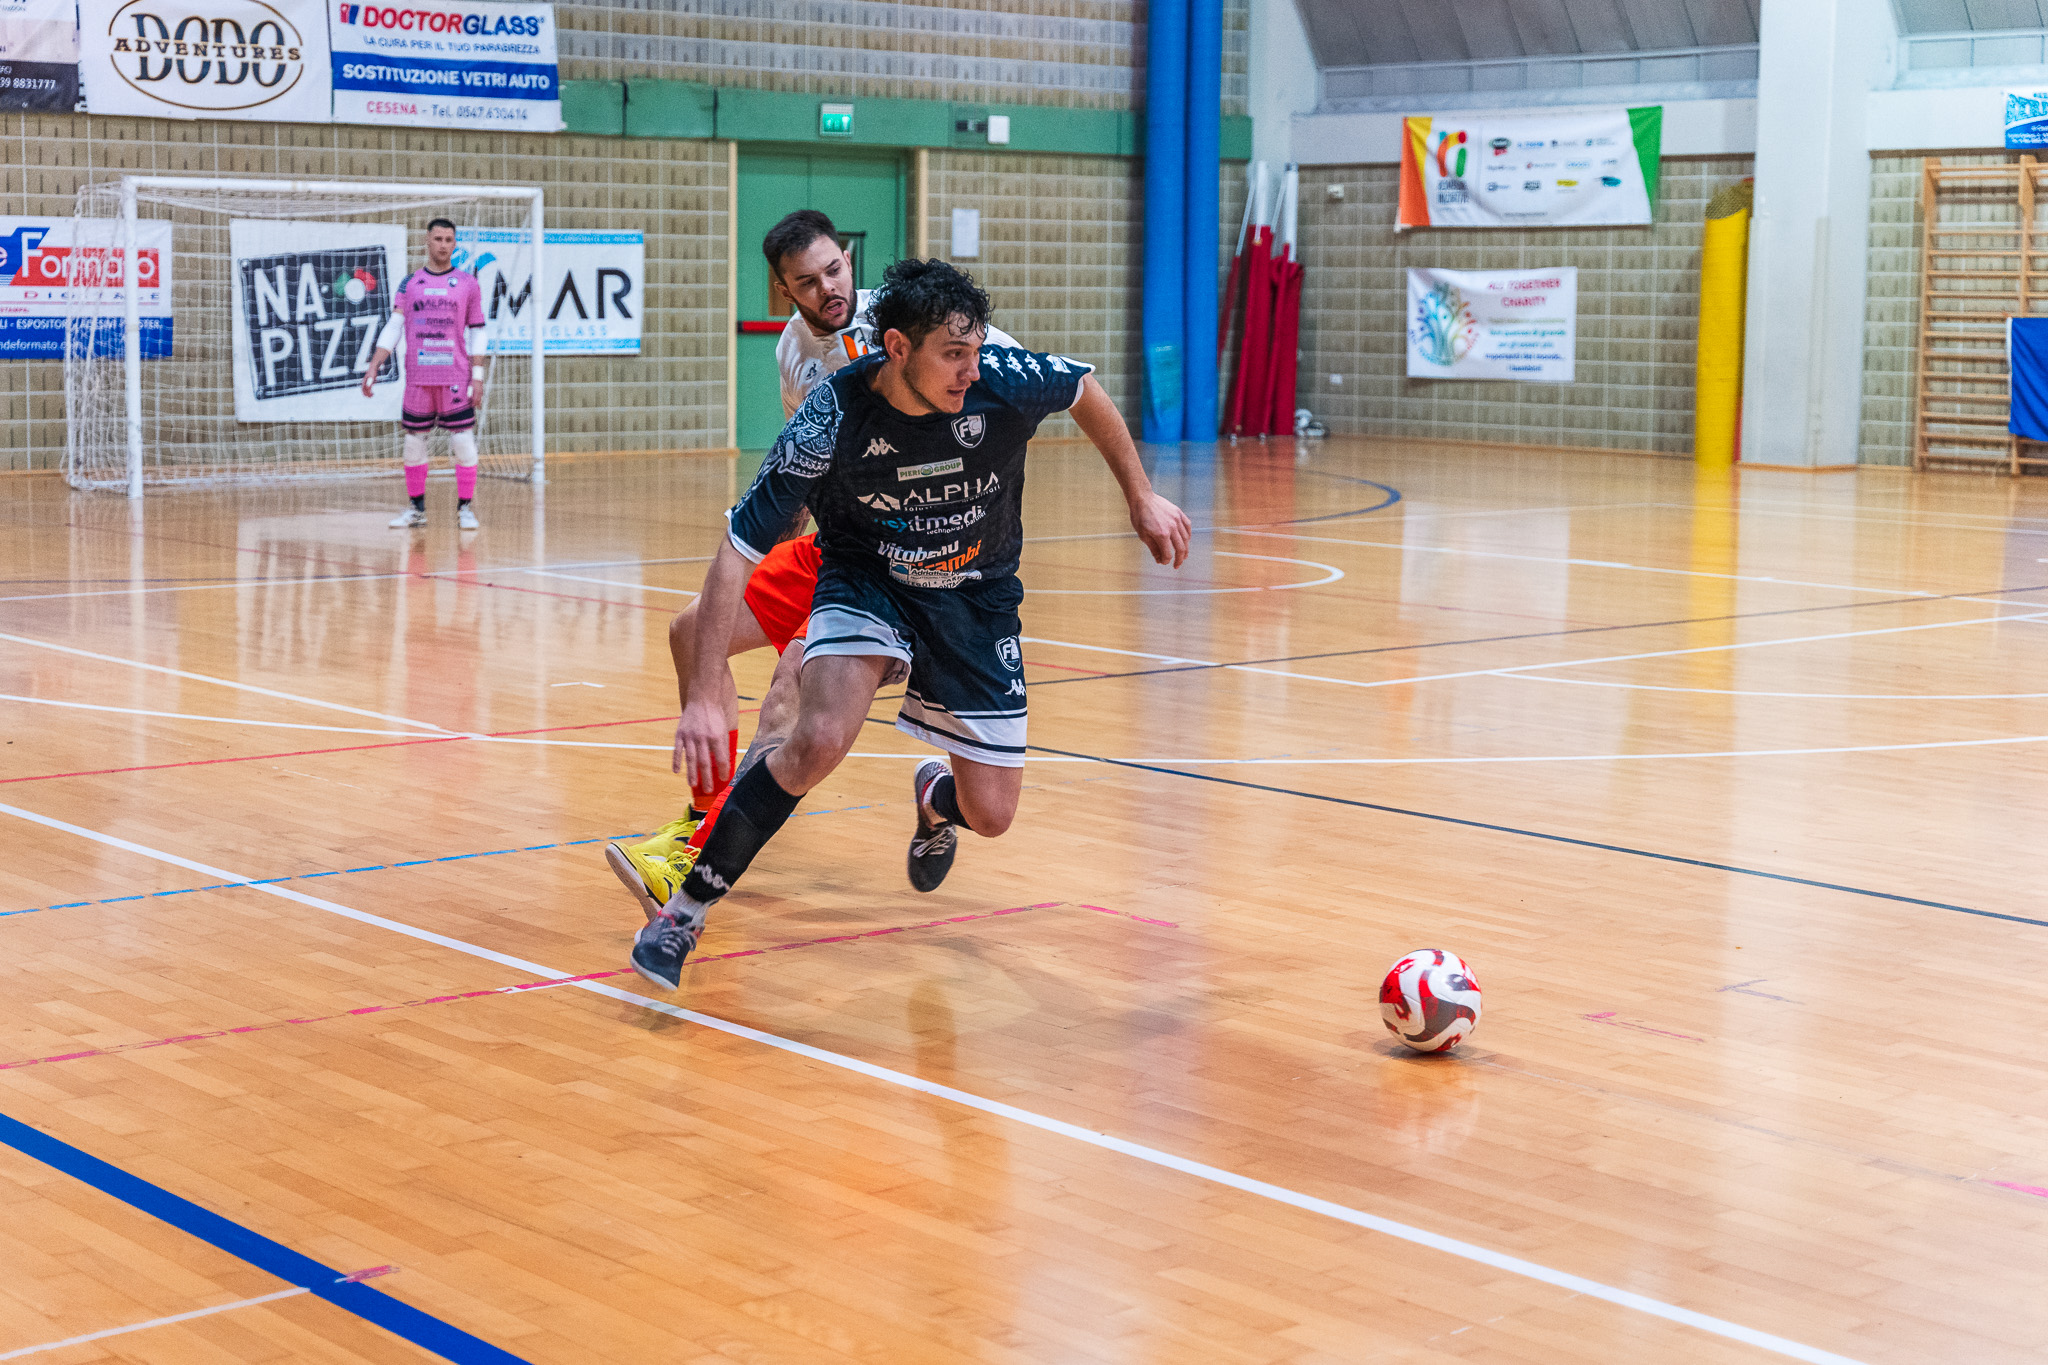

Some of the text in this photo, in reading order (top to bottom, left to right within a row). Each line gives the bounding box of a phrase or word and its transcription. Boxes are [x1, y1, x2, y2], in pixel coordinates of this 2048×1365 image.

[363, 6, 540, 36] DOCTORGLASS
[114, 38, 300, 60] ADVENTURES
[131, 13, 286, 88] DODO
[363, 35, 541, 54] LA CURA PER IL TUO PARABREZZA
[343, 64, 550, 90] SOSTITUZIONE VETRI AUTO
[367, 101, 418, 115] CESENA
[22, 232, 155, 279] Formao
[253, 263, 327, 327] NA
[473, 265, 632, 319] MAR
[900, 470, 921, 478] PIERI
[934, 462, 961, 473] GROUP
[903, 471, 999, 505] ALPHA
